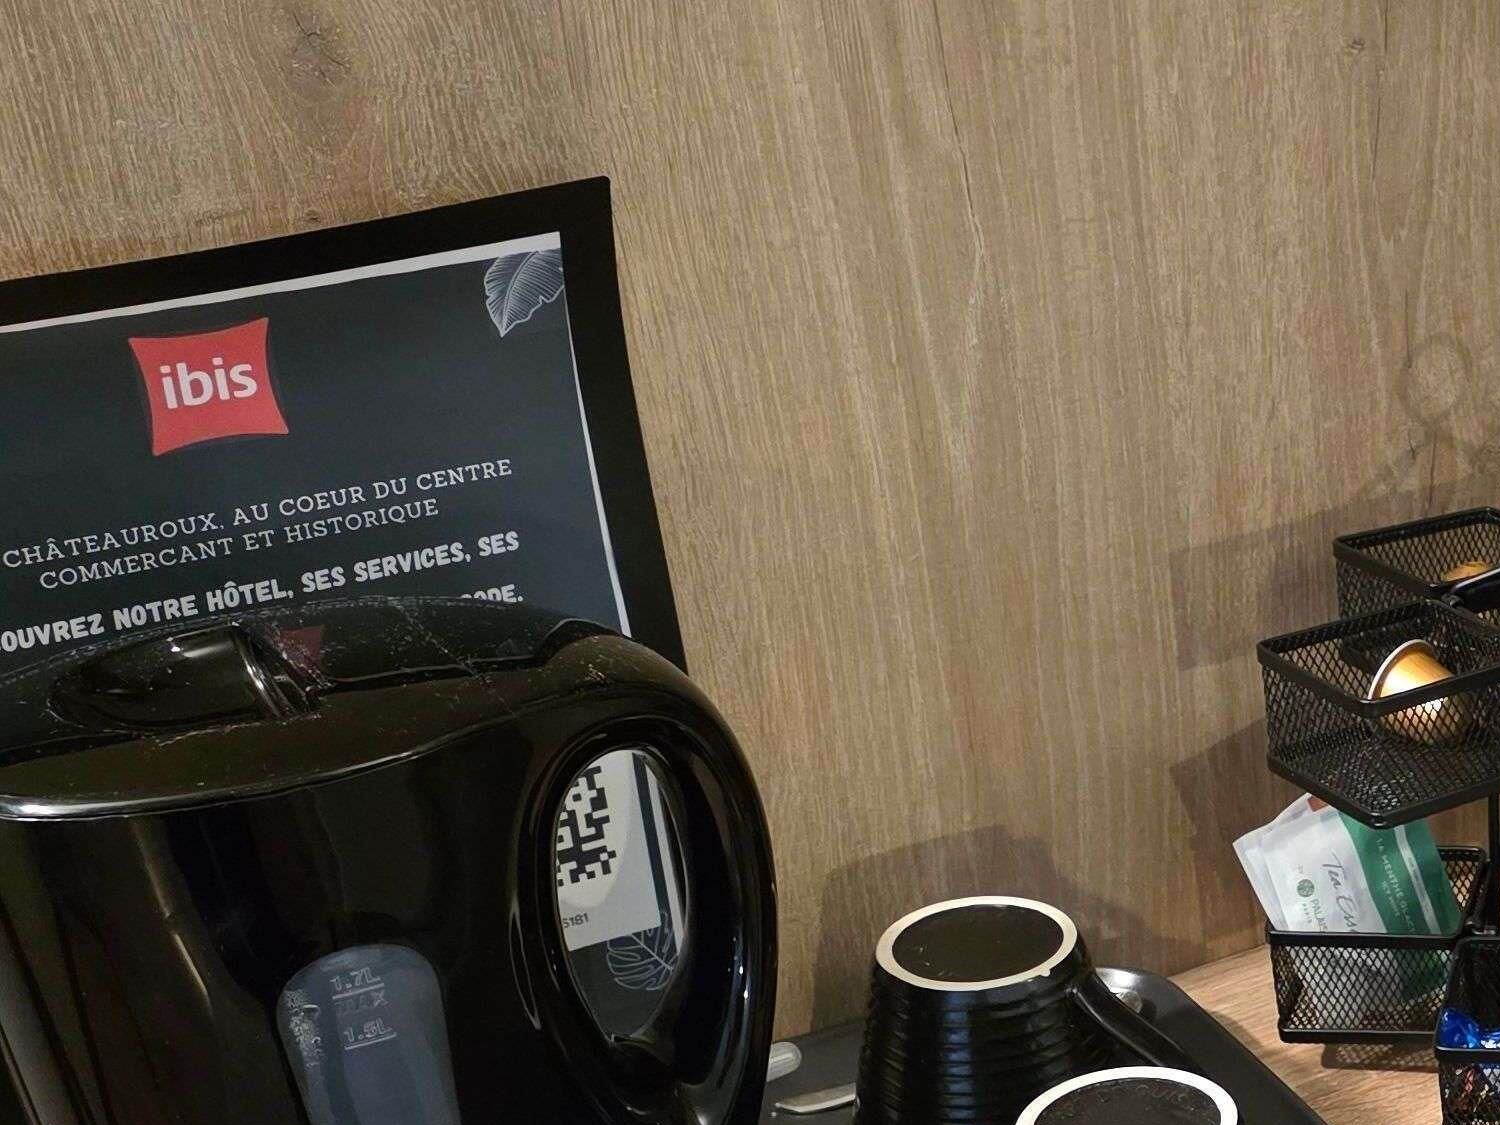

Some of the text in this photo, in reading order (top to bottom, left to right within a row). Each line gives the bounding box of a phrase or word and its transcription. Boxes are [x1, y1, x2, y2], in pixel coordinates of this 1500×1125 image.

[160, 357, 258, 410] ibis
[232, 502, 269, 527] AU
[278, 487, 367, 517] COEUR
[372, 477, 408, 500] DU
[415, 458, 513, 491] CENTRE
[39, 498, 439, 589] COMMERCANT ET HISTORIQUE
[0, 530, 520, 652] OUVREZ NOTRE HÔTEL, SES SERVICES, SES
[330, 967, 382, 992] 1.7L
